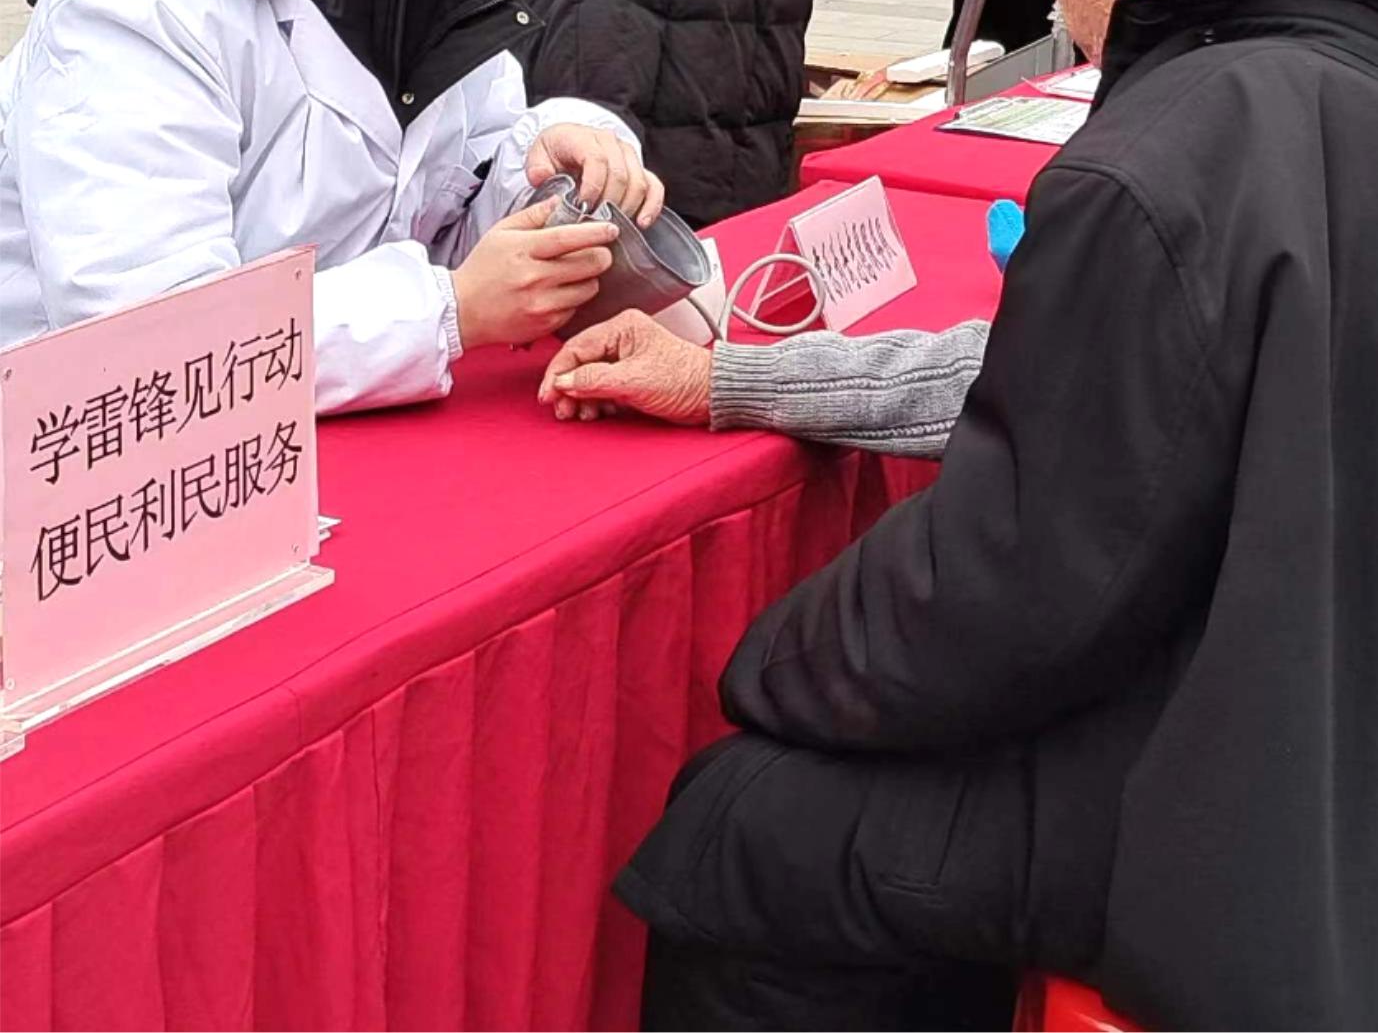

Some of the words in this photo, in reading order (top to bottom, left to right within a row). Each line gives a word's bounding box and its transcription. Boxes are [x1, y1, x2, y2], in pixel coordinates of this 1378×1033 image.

[29, 317, 302, 484] 学雷锋见行动
[31, 420, 303, 601] 便民利民服务
